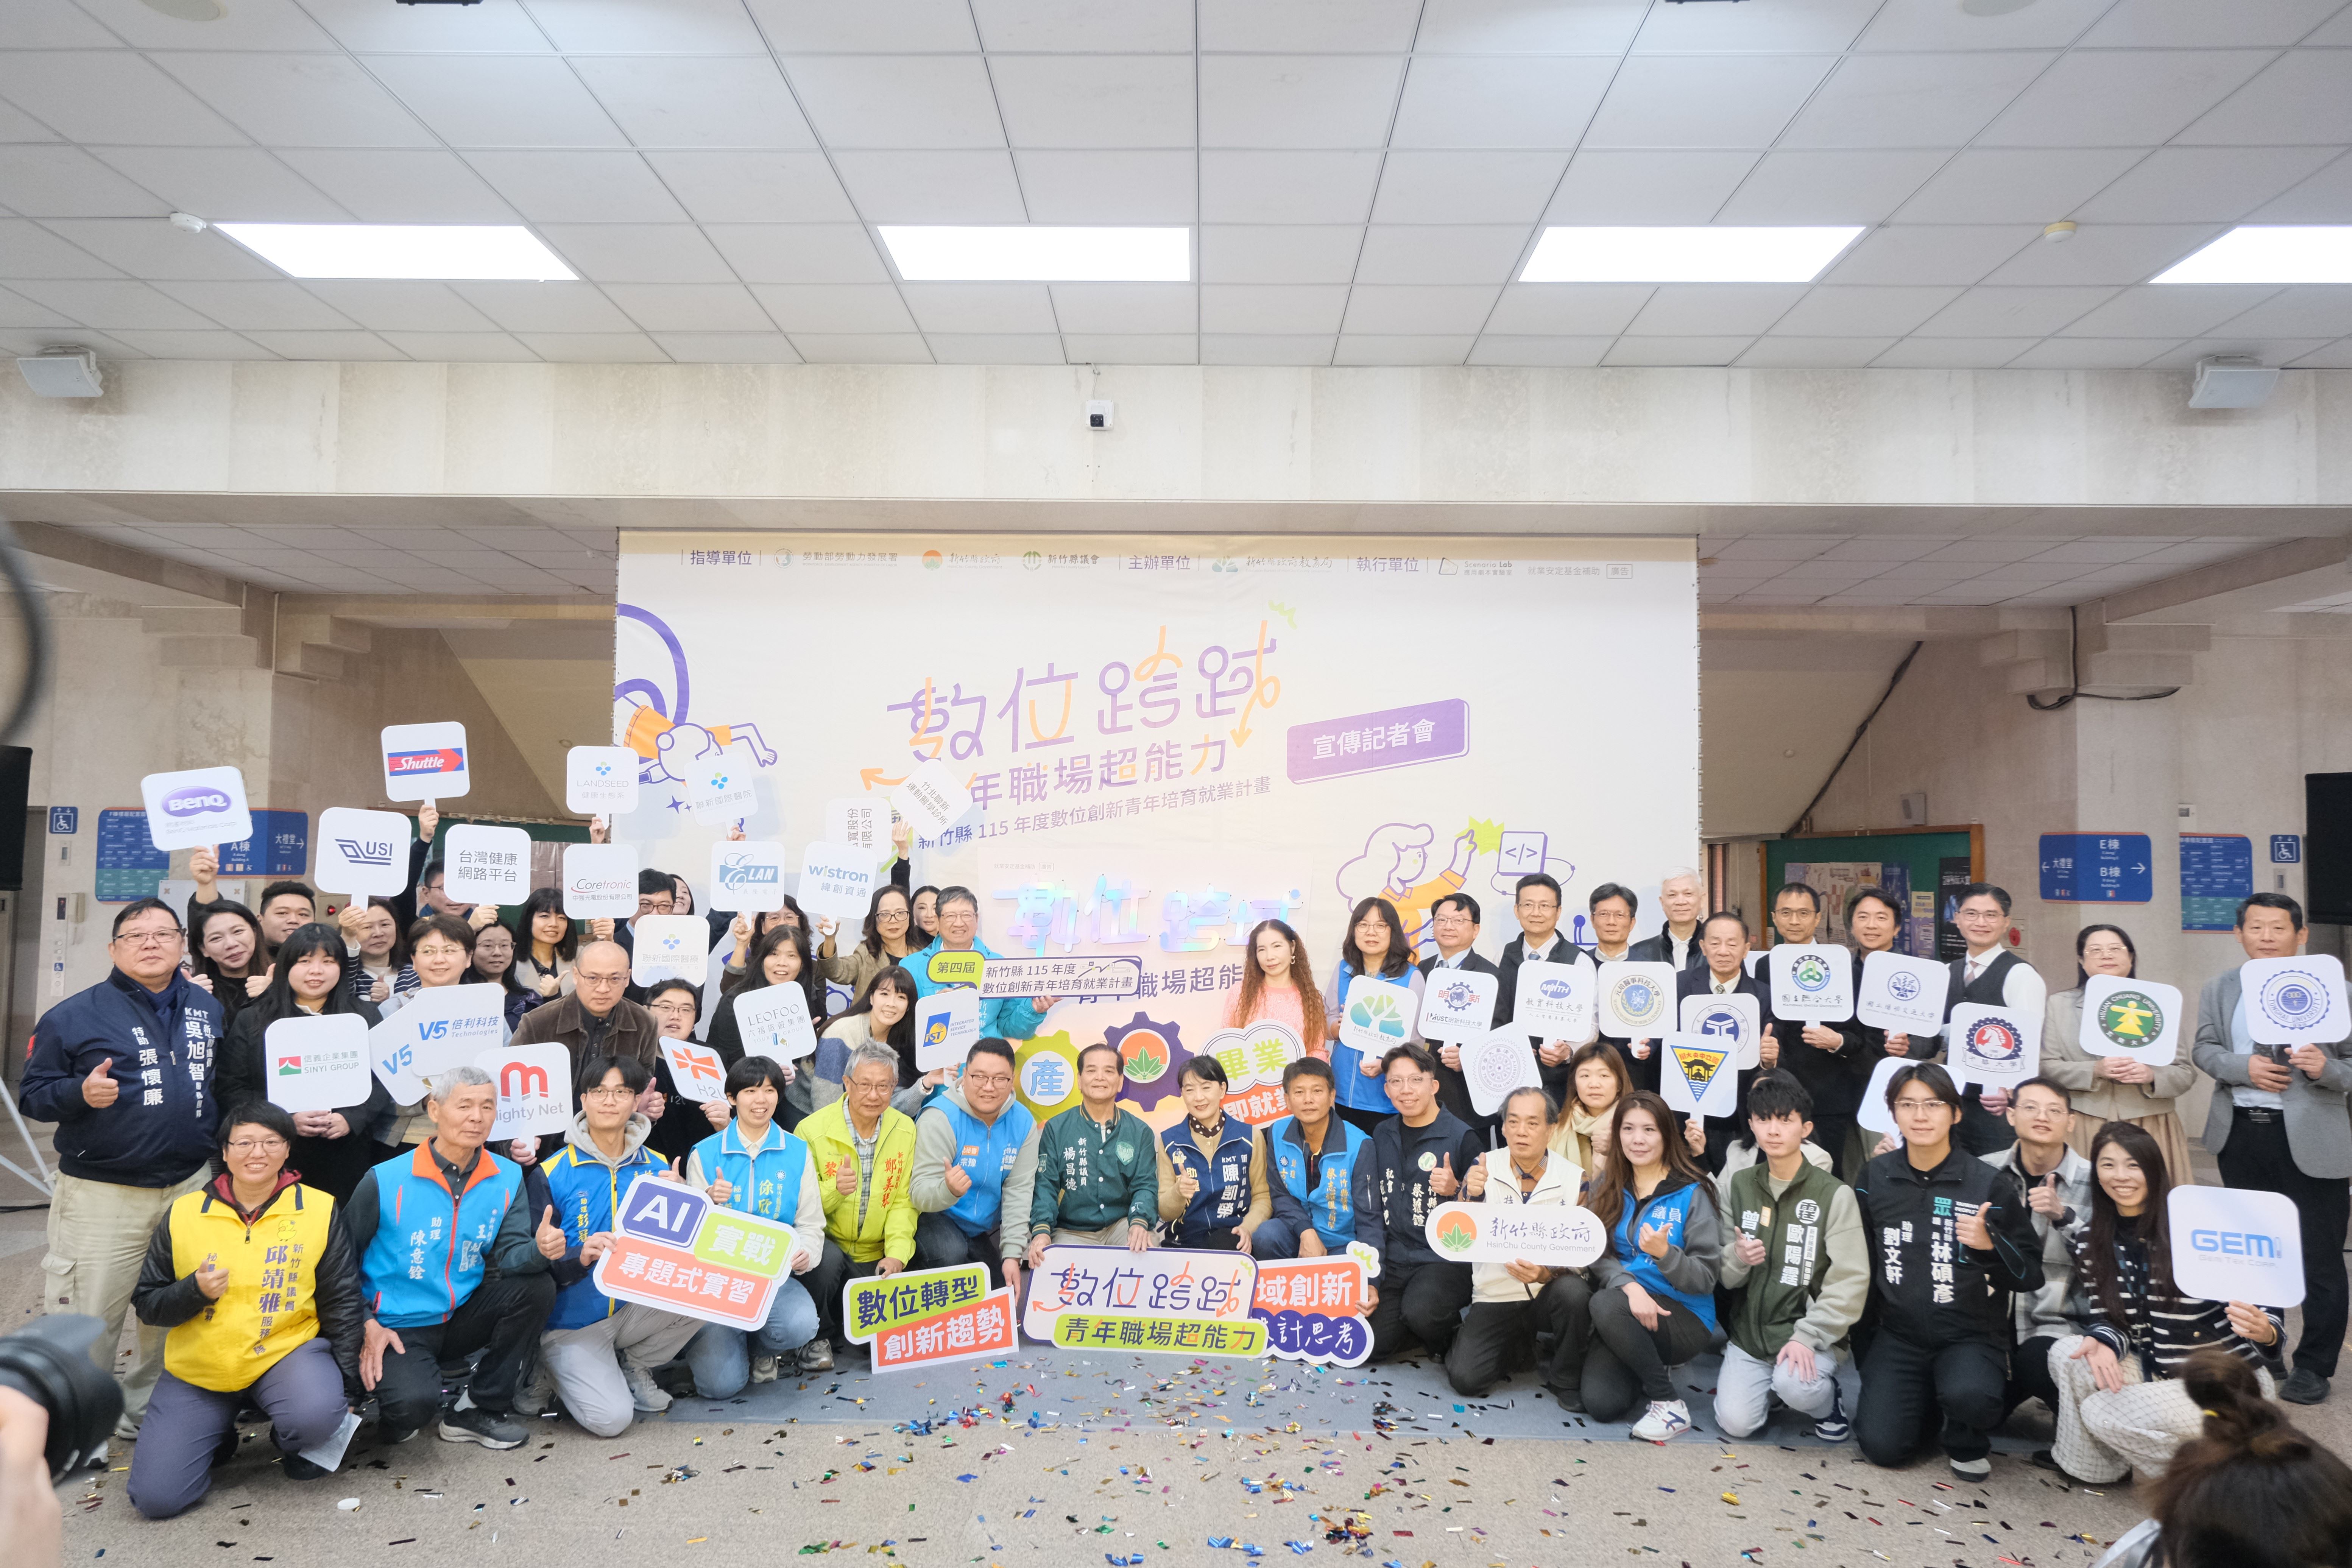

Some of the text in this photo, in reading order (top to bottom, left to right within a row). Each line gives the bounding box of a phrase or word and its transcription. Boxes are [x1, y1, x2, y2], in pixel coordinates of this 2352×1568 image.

[690, 550, 751, 565] 指導單位
[803, 552, 898, 561] 勞動部勞動力發展署
[949, 553, 1001, 563] 新竹縣政府
[1047, 554, 1099, 565] 新竹縣議會
[1128, 555, 1190, 570] 主辦單位
[1356, 556, 1418, 572] 執行單位
[1527, 566, 1600, 576] 就業安定基金補助
[1611, 567, 1629, 575] 廣告
[1313, 717, 1436, 760] 宣傳記者會
[394, 757, 444, 770] Shuttle
[965, 734, 1226, 810] 年職場超能力
[168, 794, 227, 811] BenQ
[695, 790, 752, 809] 聯新國際醫院
[906, 781, 949, 826] 運動醫學診所
[922, 781, 951, 812] 竹北聯新
[978, 821, 1008, 839] 115
[1014, 776, 1271, 835] 年度數位創新青年培育就業計畫
[275, 834, 296, 844] 大禮堂
[862, 809, 872, 849] 有限公司
[365, 841, 393, 856] USI
[2099, 839, 2120, 850] E棟
[459, 850, 518, 866] 台灣健康
[2053, 858, 2073, 869] 大禮堂
[458, 866, 517, 882] 網路平台
[725, 853, 775, 894] ELAN
[809, 865, 868, 883] wistron
[2100, 867, 2121, 878] B棟
[576, 878, 632, 890] Coretronic
[821, 883, 867, 897] 緯創資通
[642, 954, 699, 963] 聯新國際醫療
[937, 962, 975, 974] 第四屆
[986, 963, 1076, 978] 新竹縣 115 年度
[982, 977, 1133, 994] 數位創新青年培育就業計畫
[1438, 990, 1450, 999] 明
[1468, 994, 1480, 1004] 新
[1526, 998, 1583, 1013] 敏實科技大學
[2292, 997, 2321, 1022] UNIVERSITY
[184, 1007, 209, 1019] KMT
[452, 1016, 499, 1030] 倍利科技
[748, 1005, 799, 1026] LEOFOO
[2100, 994, 2162, 1031] HSUAN CHUANG UNIVERSITY
[132, 1026, 149, 1046] 特助
[419, 1020, 449, 1041] V5
[452, 1028, 498, 1038] Technologies
[748, 1015, 805, 1038] 六福旅遊集團
[753, 1033, 781, 1044] TOURIM
[185, 1021, 205, 1081] 吳旭智
[304, 1051, 358, 1063] 信義企業集團
[382, 1044, 412, 1075] V5
[1216, 1038, 1287, 1081] 畢業
[139, 1048, 164, 1106] 張懷廉
[330, 1062, 359, 1071] GROUP
[1030, 1059, 1065, 1096] 產
[496, 1101, 564, 1123] ighty Net
[958, 1158, 977, 1167] 宗豫
[1063, 1147, 1077, 1191] 楊昌德
[1078, 1137, 1088, 1186] 新竹縣議員
[881, 1158, 897, 1208] 鄭美琴
[1217, 1164, 1240, 1218] 陳凱榮
[633, 1195, 692, 1233] AI
[1651, 1205, 1682, 1224] 議員
[430, 1216, 442, 1240] 助理
[1490, 1216, 1591, 1242] 新竹縣政府
[1901, 1221, 1913, 1242] 助理
[709, 1224, 777, 1266] 實戰
[1487, 1241, 1595, 1252] HsinChu County Government
[2191, 1229, 2274, 1258] GEM
[408, 1230, 427, 1280] 陳意銓
[1779, 1223, 1805, 1286] 歐陽霆
[1883, 1227, 1903, 1284] 劉文軒
[259, 1245, 288, 1314] 邱靖雅
[285, 1244, 304, 1311] 新竹縣議員
[618, 1251, 756, 1305] 專題式實習
[1931, 1241, 1954, 1303] 林碩彥
[1051, 1261, 1242, 1312] 數位跨域
[1257, 1269, 1353, 1308] 域創新
[857, 1275, 979, 1329] 數位轉型
[253, 1317, 273, 1356] 服務隊
[884, 1304, 1005, 1360] 創新趨勢
[1065, 1318, 1256, 1350] 青年職場超能力
